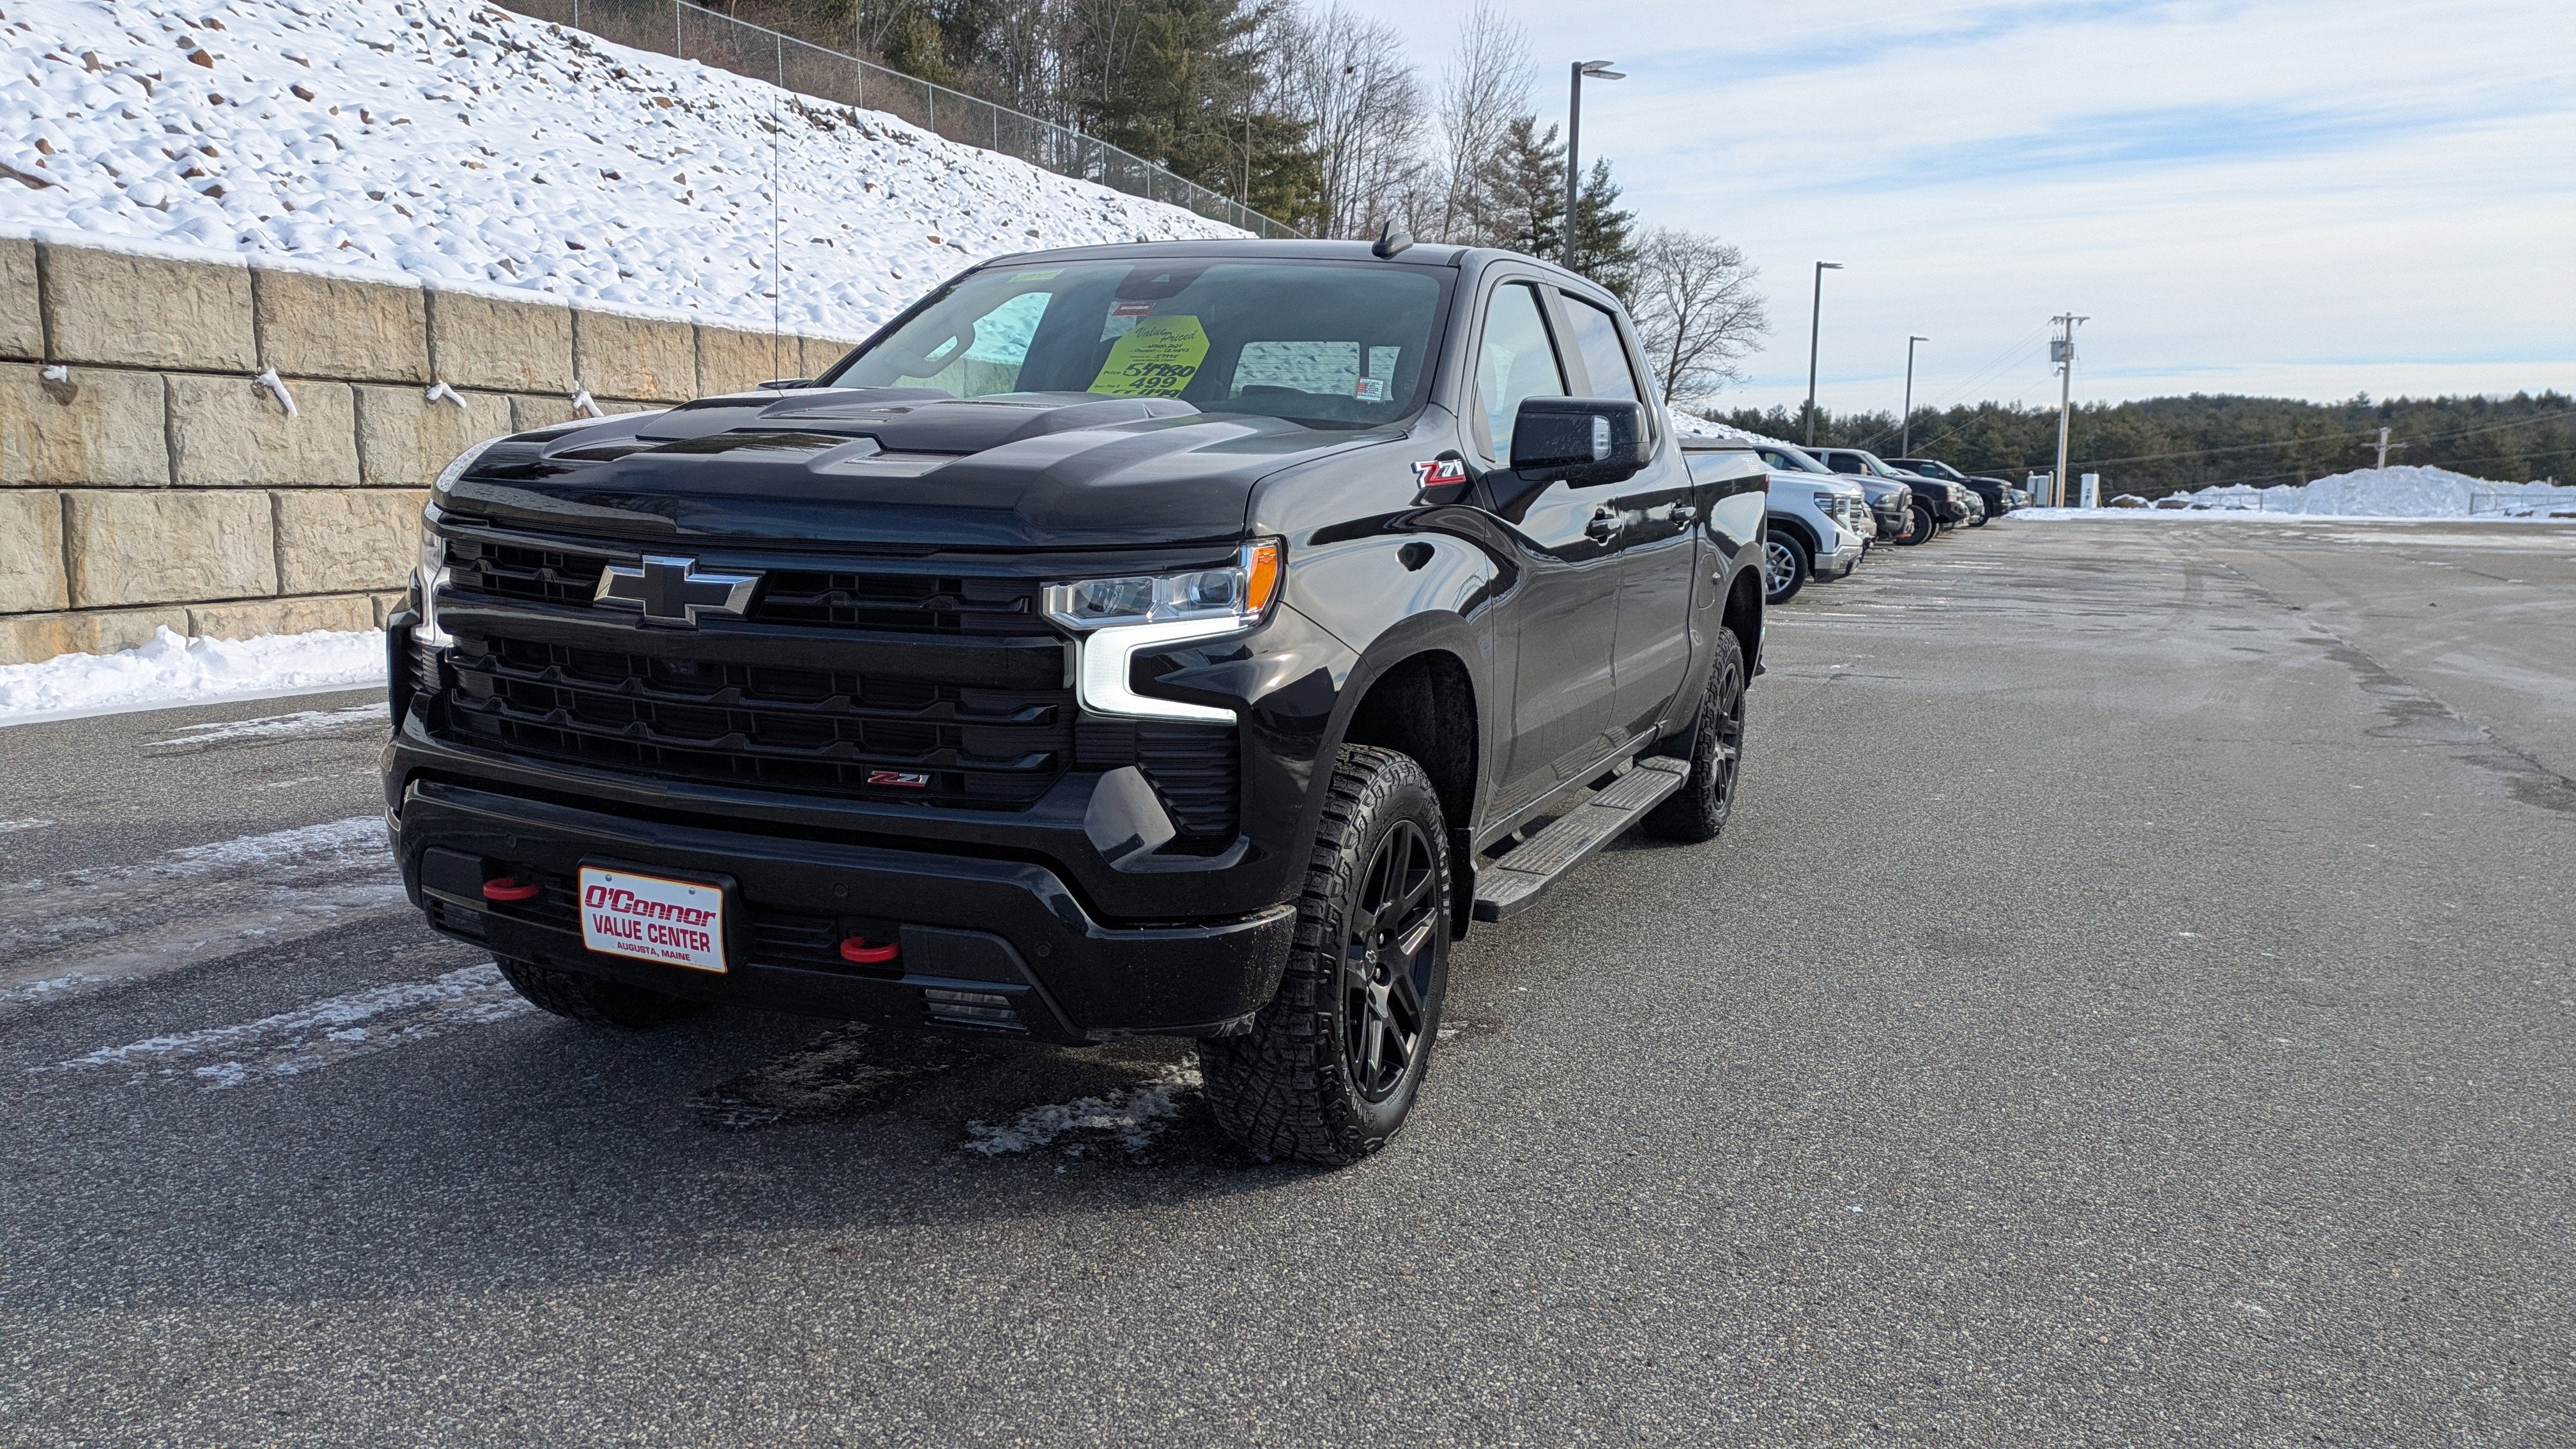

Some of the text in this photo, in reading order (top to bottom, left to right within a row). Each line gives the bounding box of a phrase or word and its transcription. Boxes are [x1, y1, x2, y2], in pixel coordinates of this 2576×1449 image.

[1135, 326, 1167, 338] Value
[1160, 329, 1198, 343] Priced
[1128, 377, 1177, 389] 499
[1411, 459, 1466, 489] Z71
[868, 770, 930, 787] Z71
[585, 885, 717, 927] O'Connor
[593, 914, 711, 953] VALUE CENTER
[617, 942, 691, 962] AUGUSTA, MAINE
